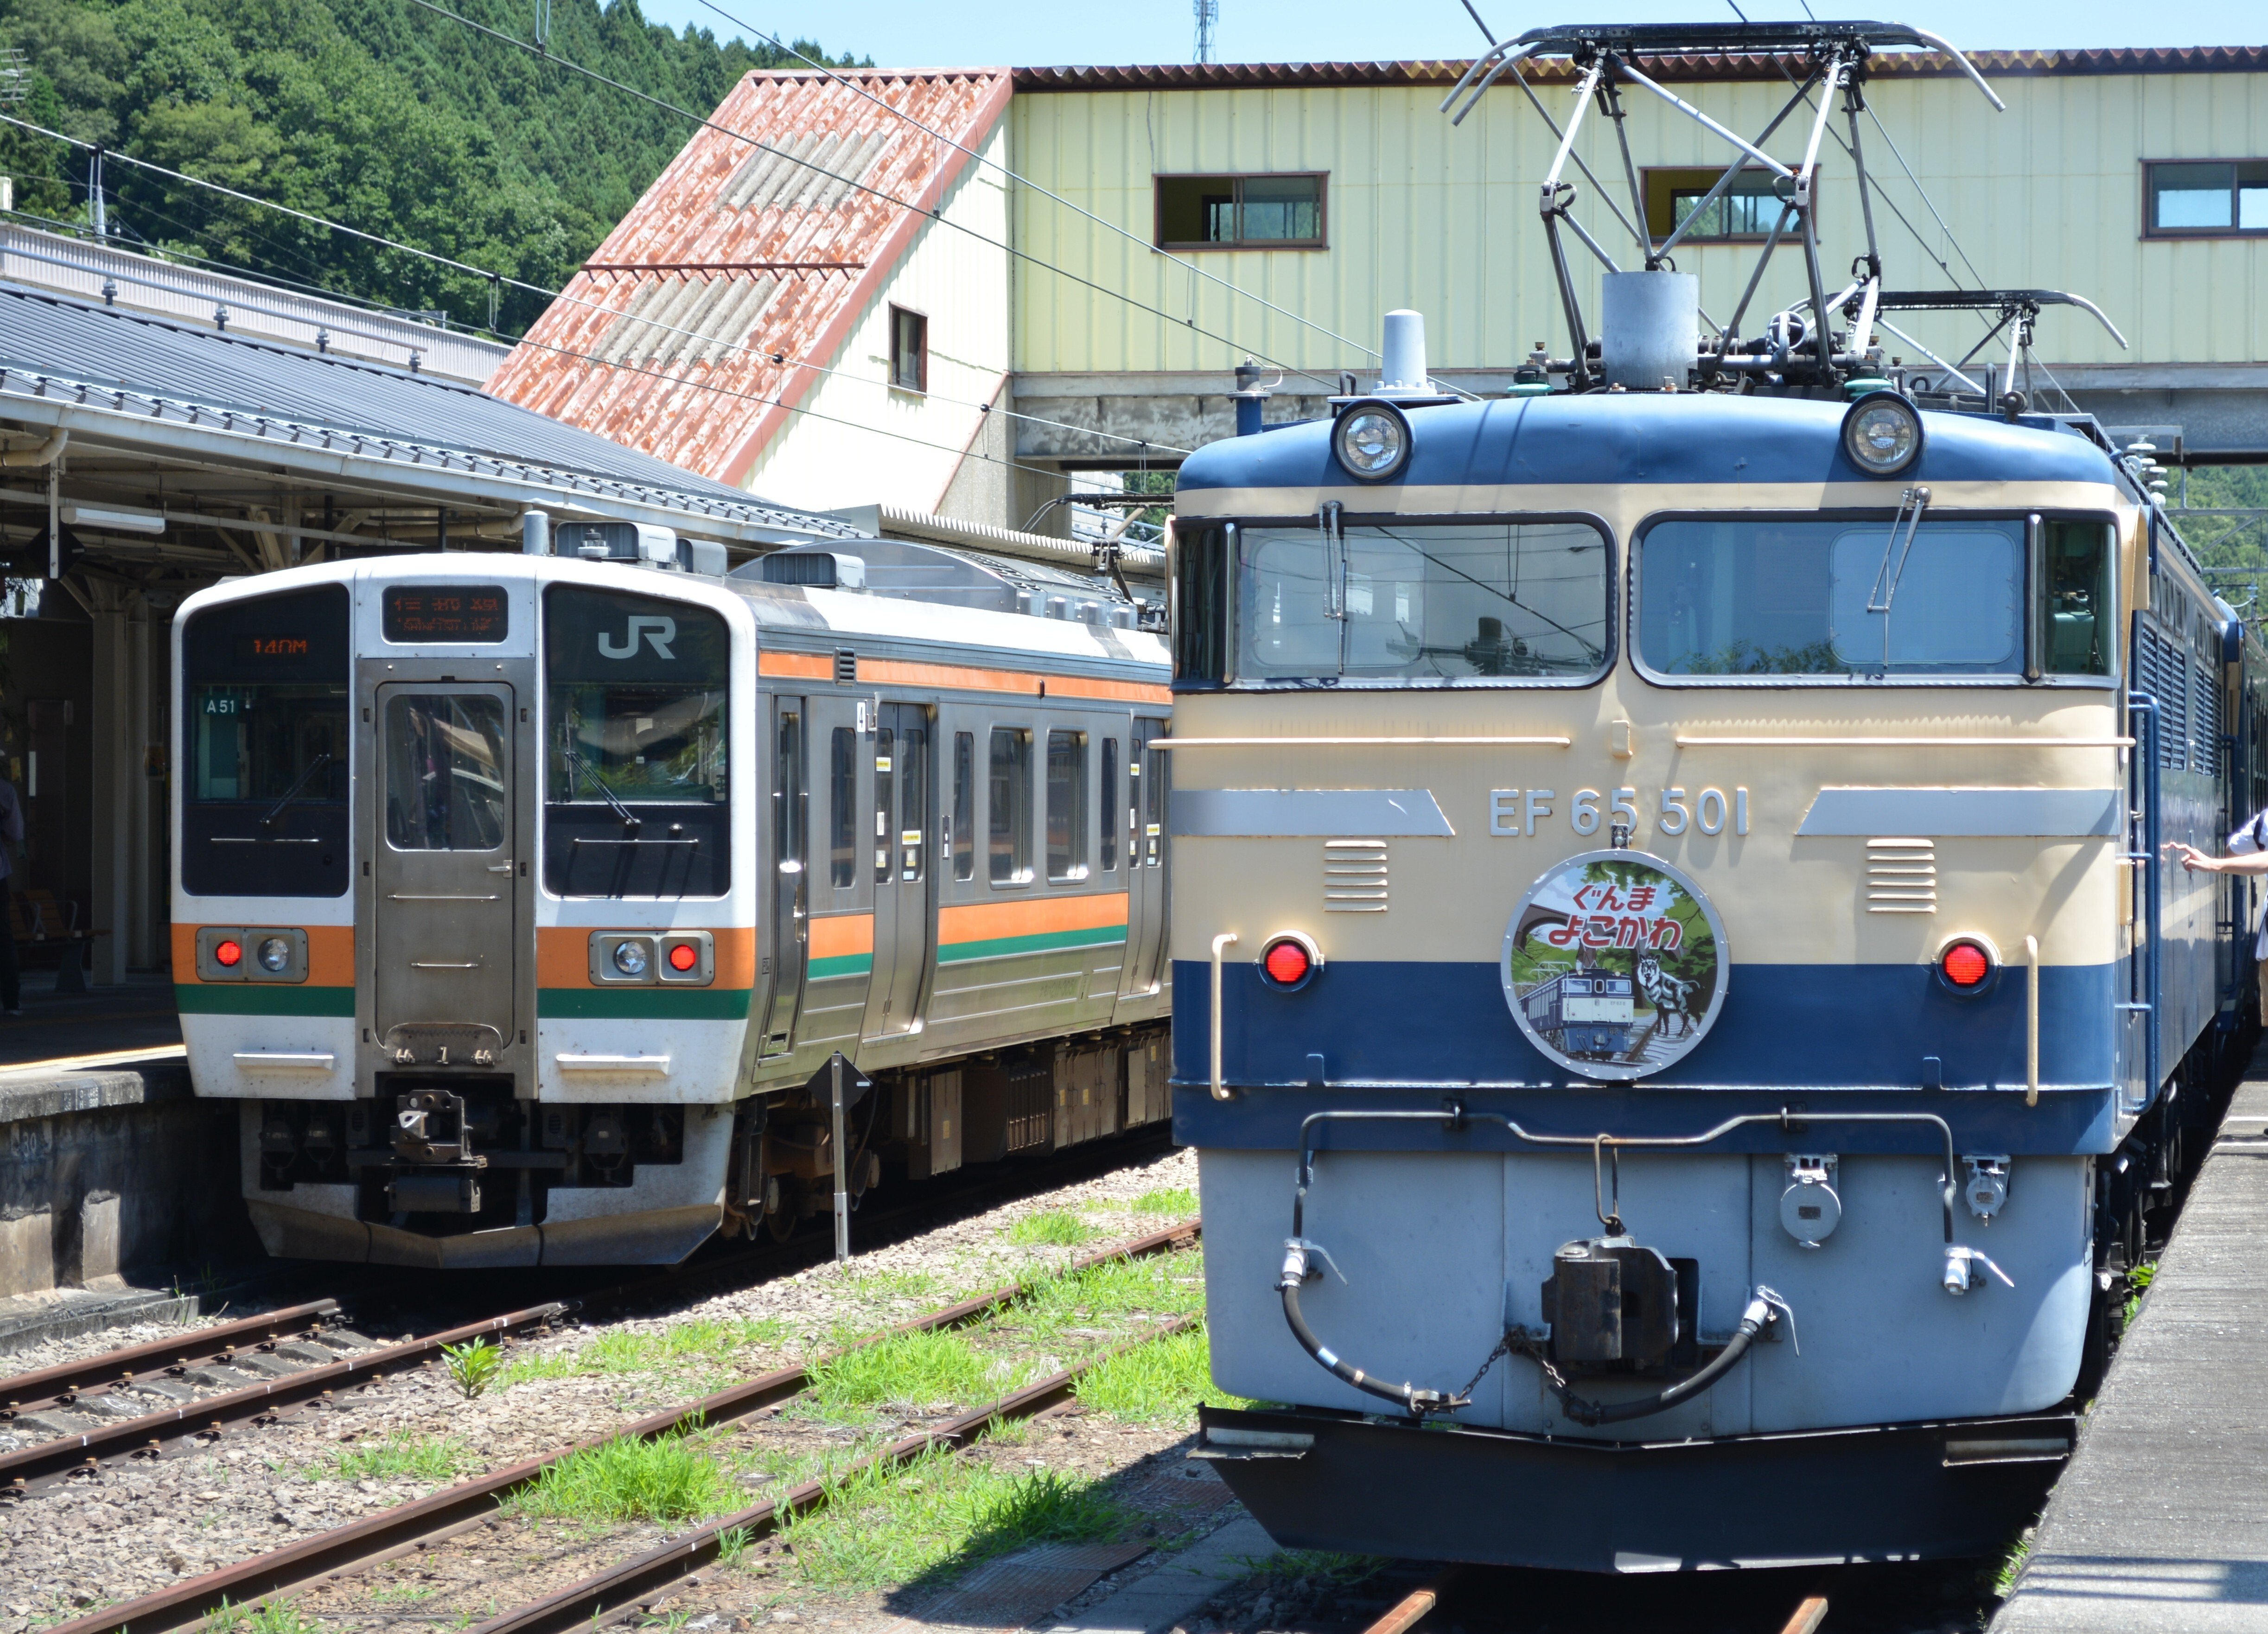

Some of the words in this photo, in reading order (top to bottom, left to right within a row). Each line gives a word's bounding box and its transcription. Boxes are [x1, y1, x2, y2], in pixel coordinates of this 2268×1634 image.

[598, 615, 676, 659] JR
[1490, 788, 1555, 836] EF
[1570, 787, 1638, 836] 65
[1659, 787, 1748, 836] 501
[1572, 884, 1657, 912] ぐんま
[1548, 914, 1683, 951] よこかわ
